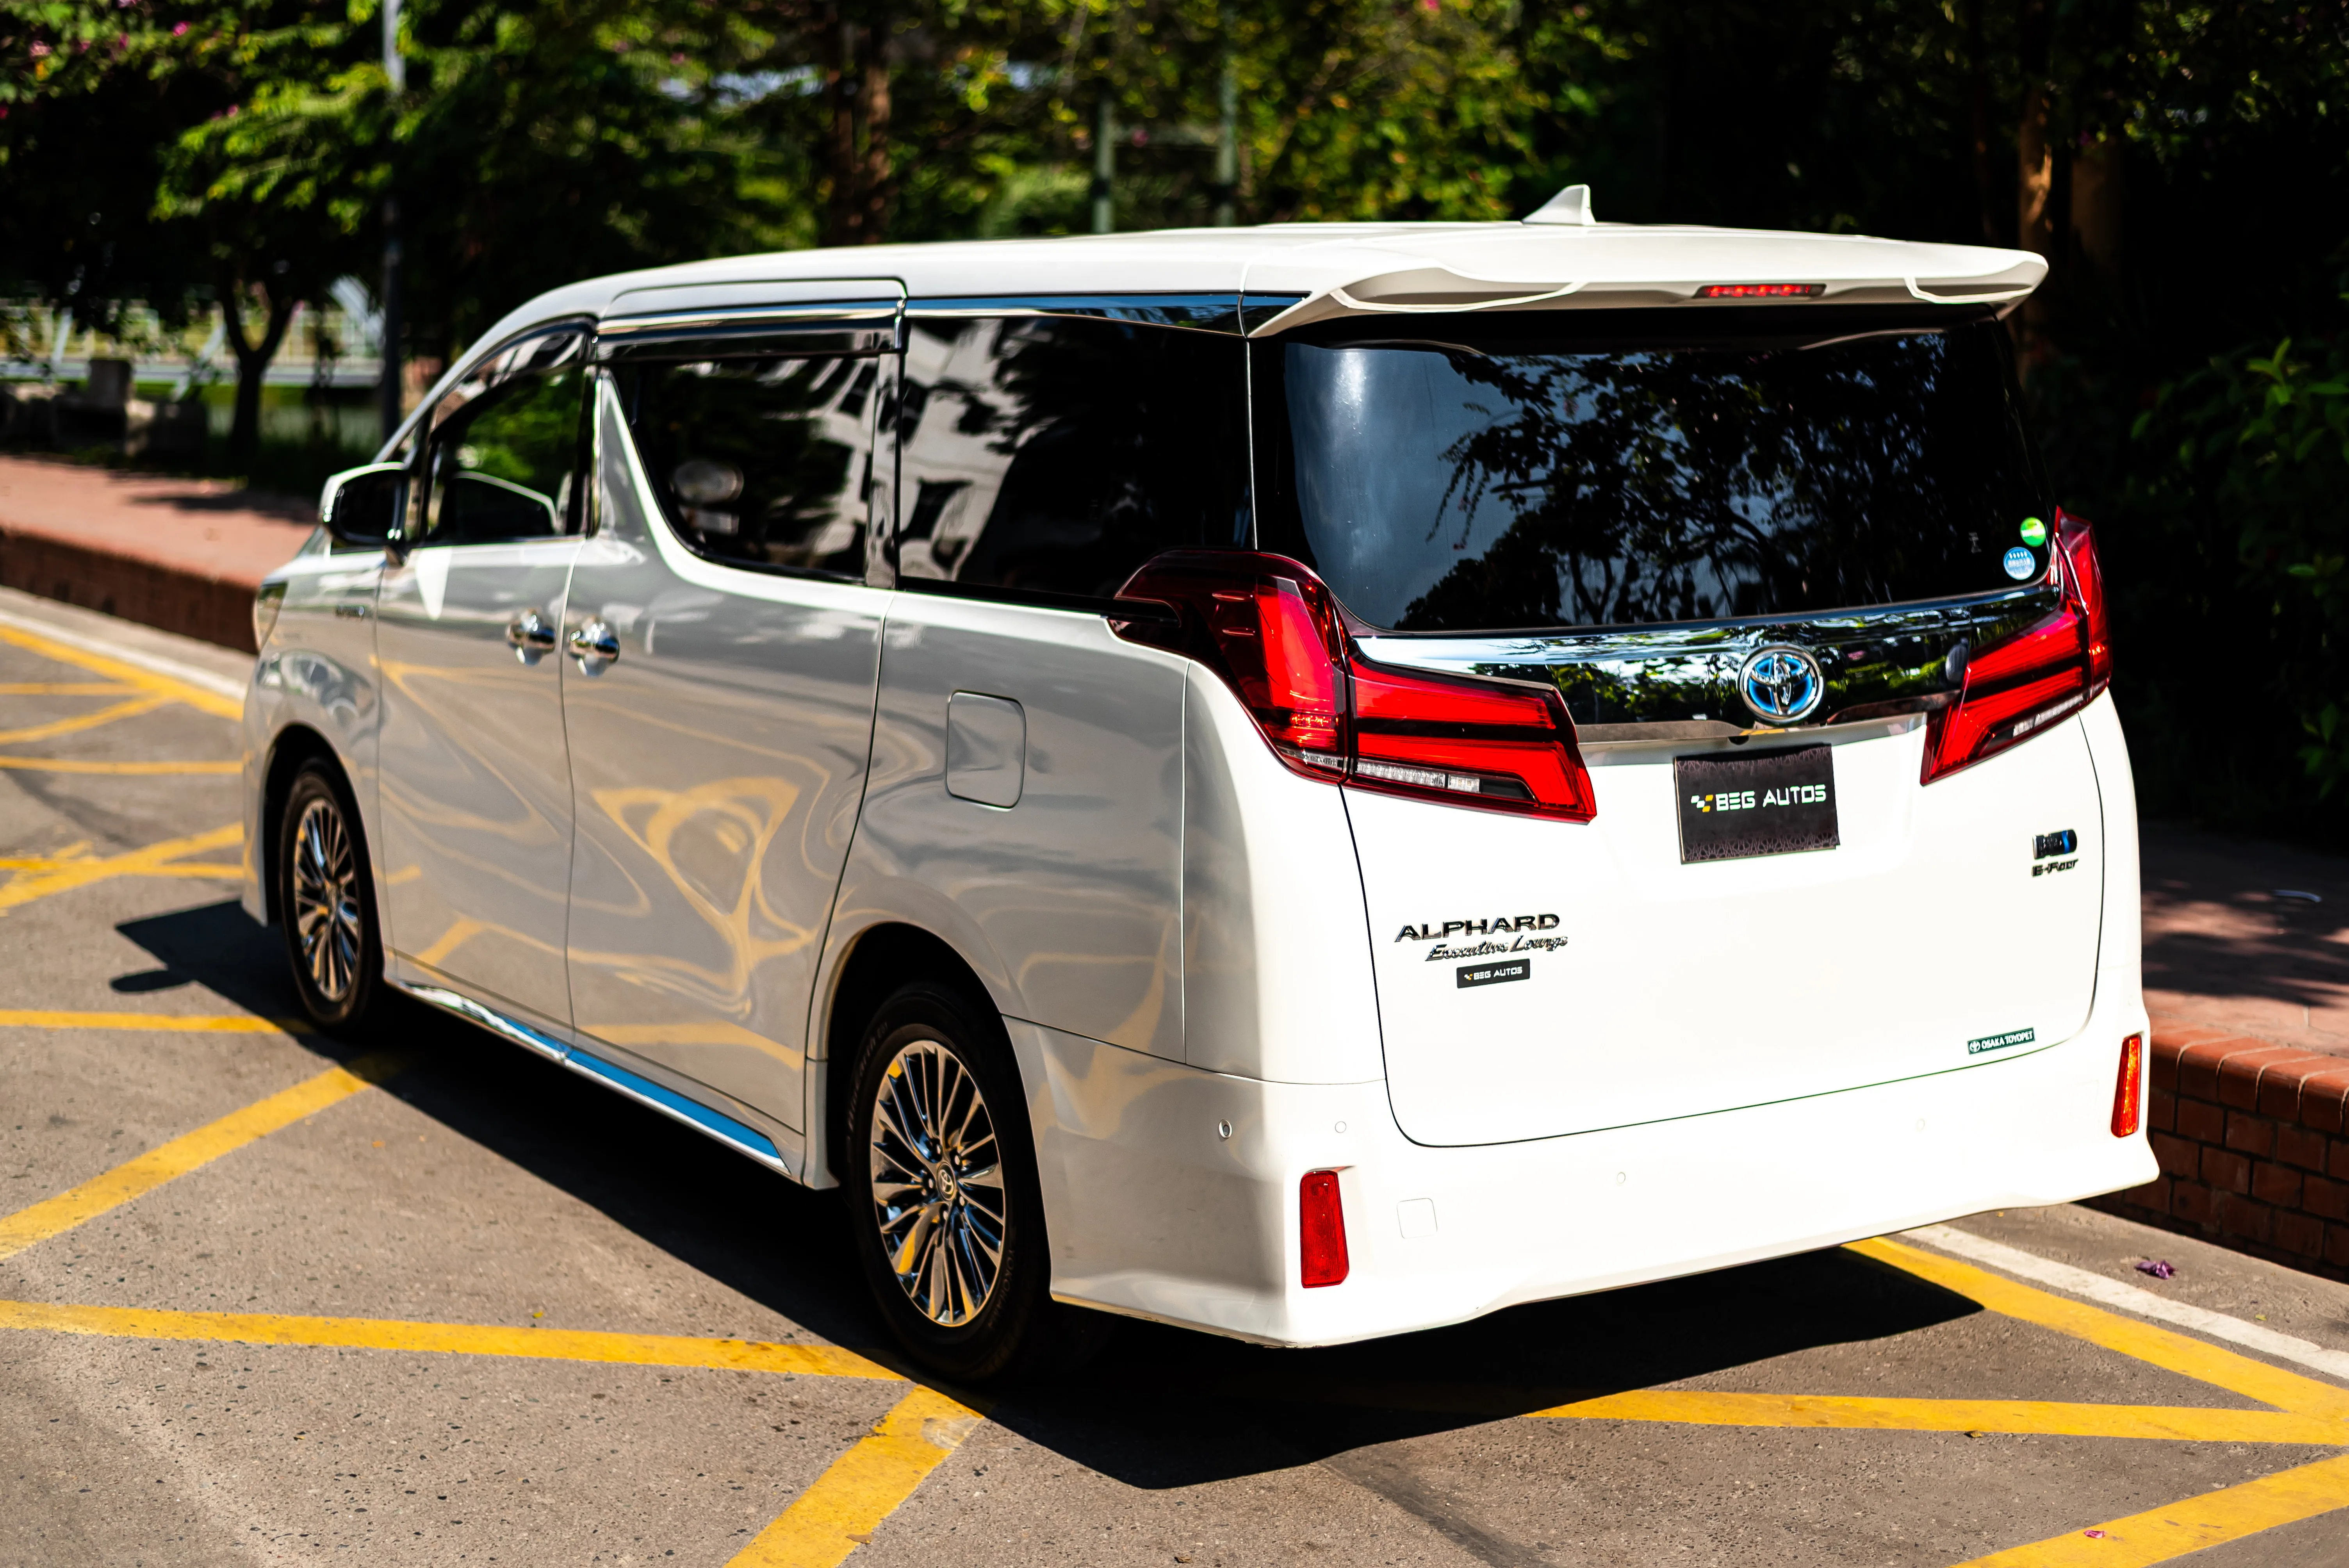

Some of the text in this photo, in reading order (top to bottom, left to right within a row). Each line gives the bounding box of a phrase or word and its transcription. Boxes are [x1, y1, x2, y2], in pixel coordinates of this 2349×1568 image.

[1715, 784, 1826, 811] BEG AUTOS
[1394, 913, 1560, 943] ALPHARD
[1425, 935, 1568, 961] Executive Lounge
[1473, 966, 1522, 980] BEG AUTOS
[1981, 1030, 2033, 1049] OSAKA TOYOPET
[987, 1249, 1015, 1330] YOKOHAMA
